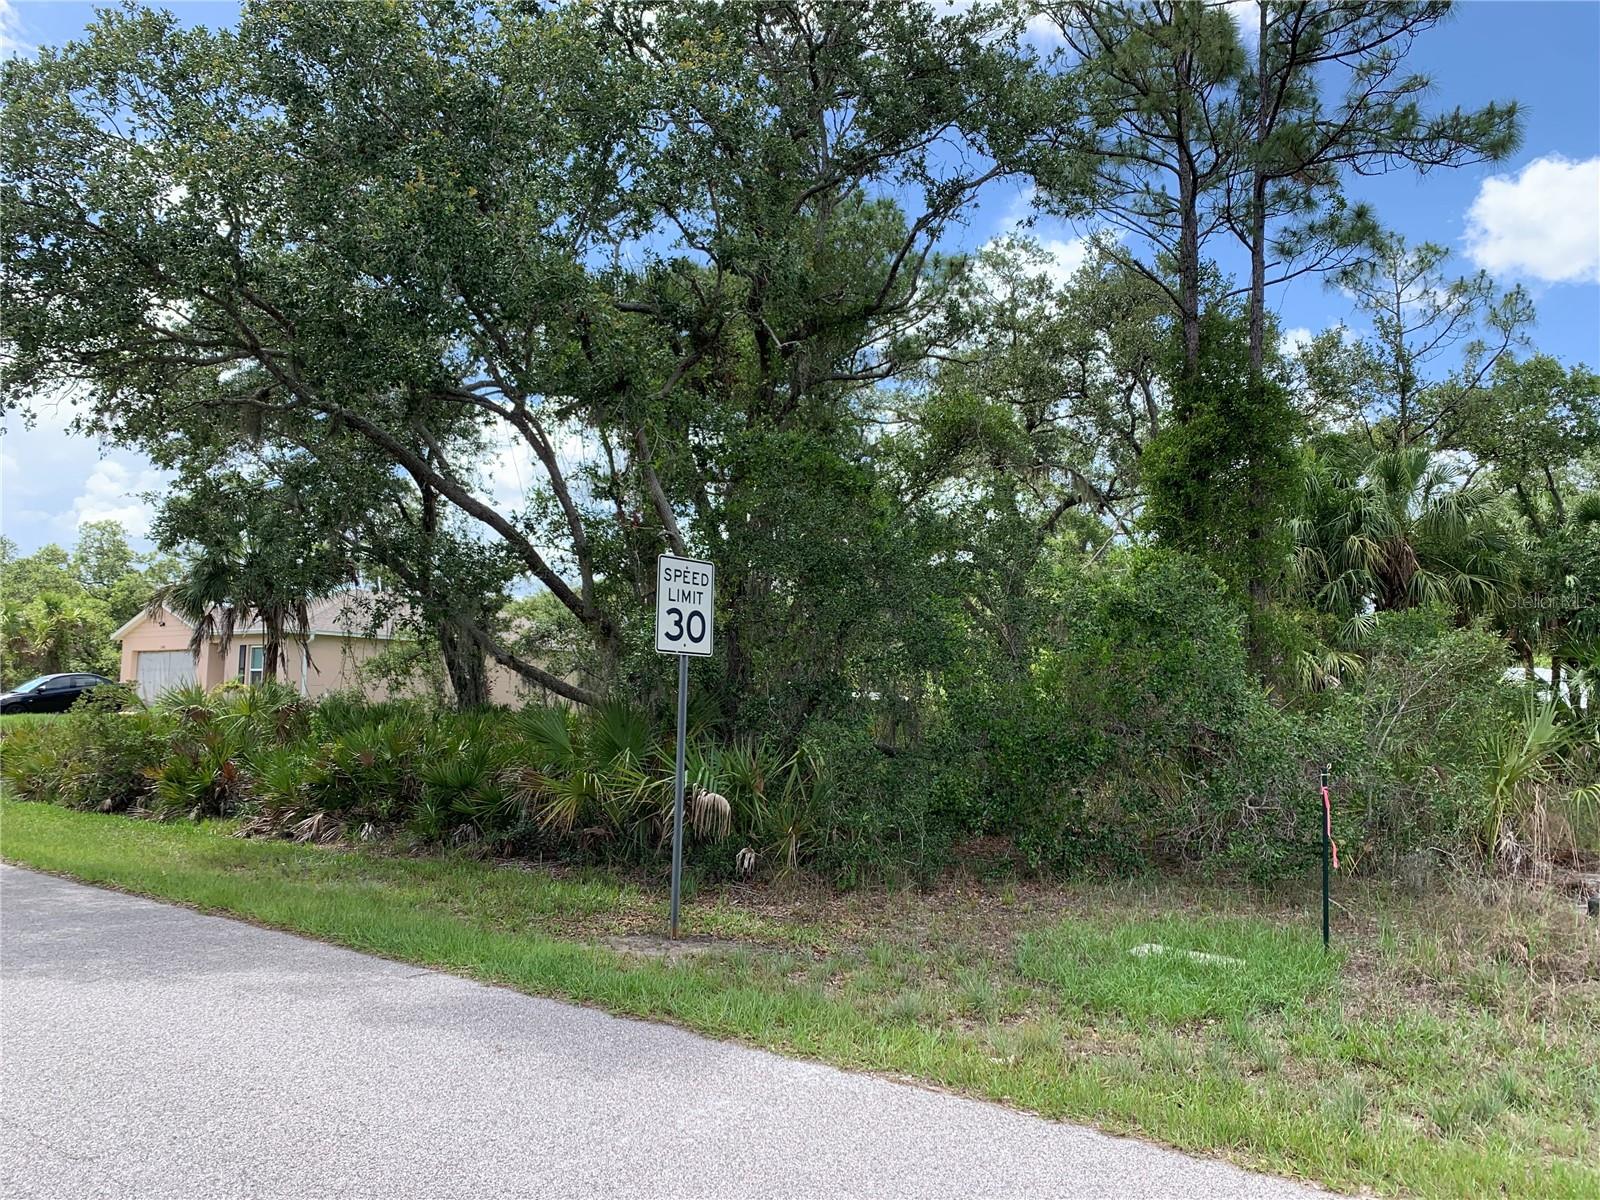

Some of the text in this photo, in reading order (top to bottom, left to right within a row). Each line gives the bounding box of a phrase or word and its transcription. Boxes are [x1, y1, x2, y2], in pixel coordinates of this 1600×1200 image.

[664, 568, 709, 586] SPEED
[668, 588, 704, 605] LIMIT
[664, 608, 706, 643] 30
